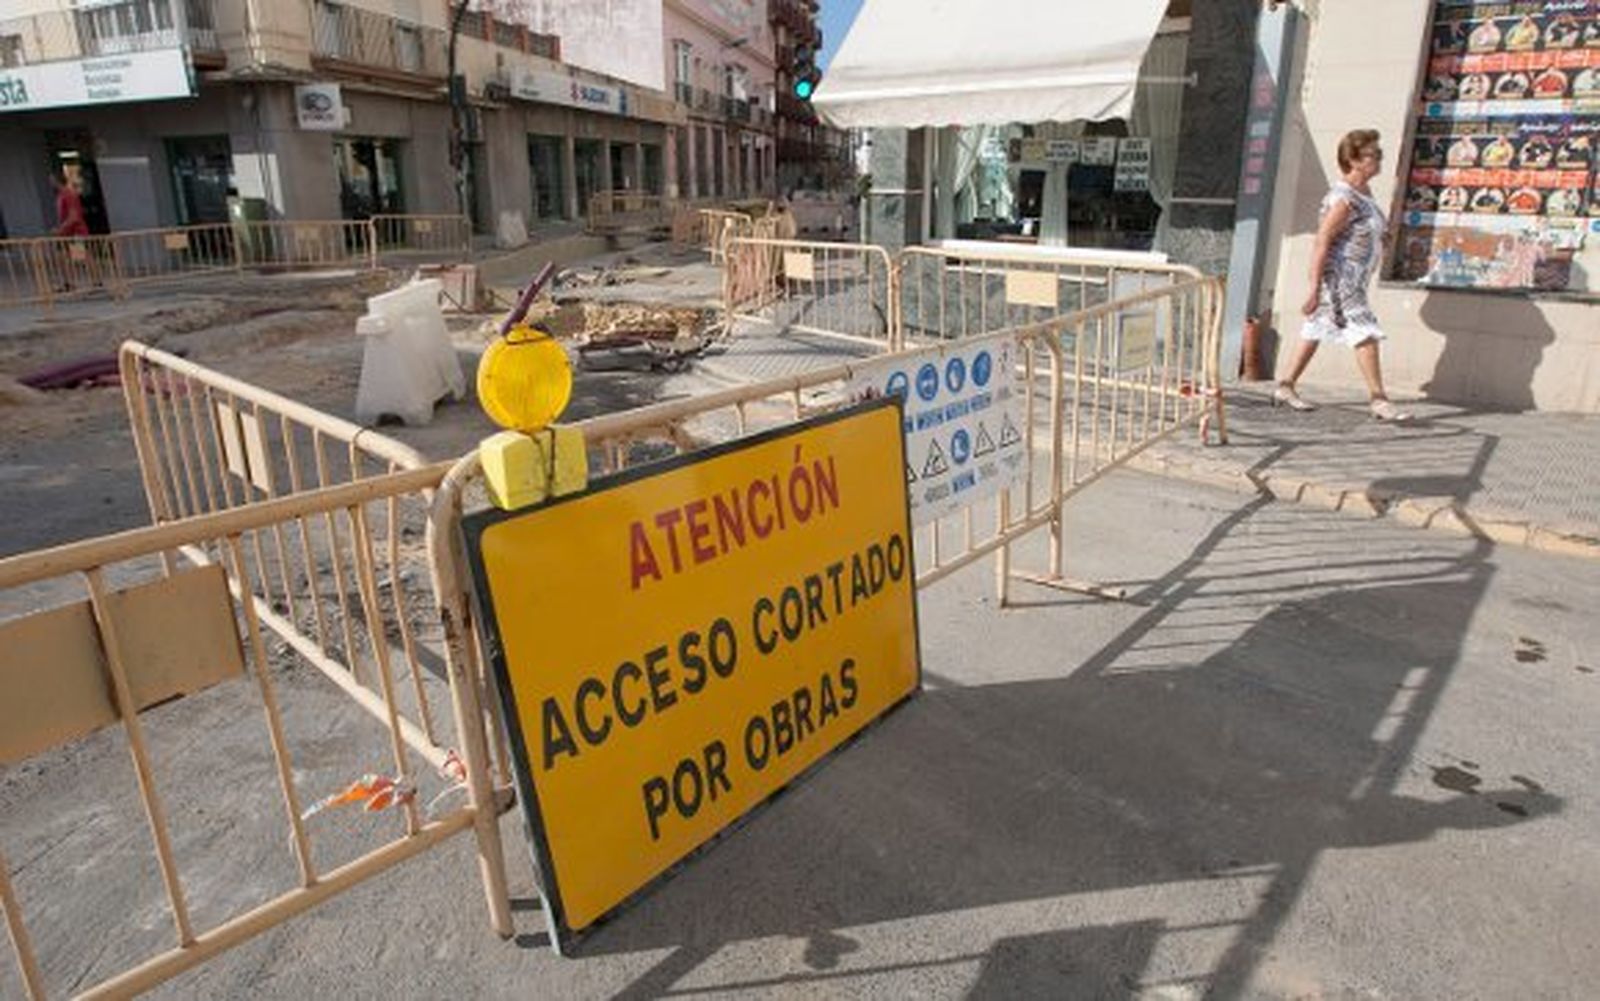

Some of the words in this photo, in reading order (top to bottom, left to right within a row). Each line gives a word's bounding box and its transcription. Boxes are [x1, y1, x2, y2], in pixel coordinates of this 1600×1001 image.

[629, 444, 840, 591] ATENCIÓN
[540, 616, 738, 772] ACCESO
[752, 533, 905, 656] CORTADO
[641, 739, 732, 841] POR
[743, 658, 859, 772] OBRAS
